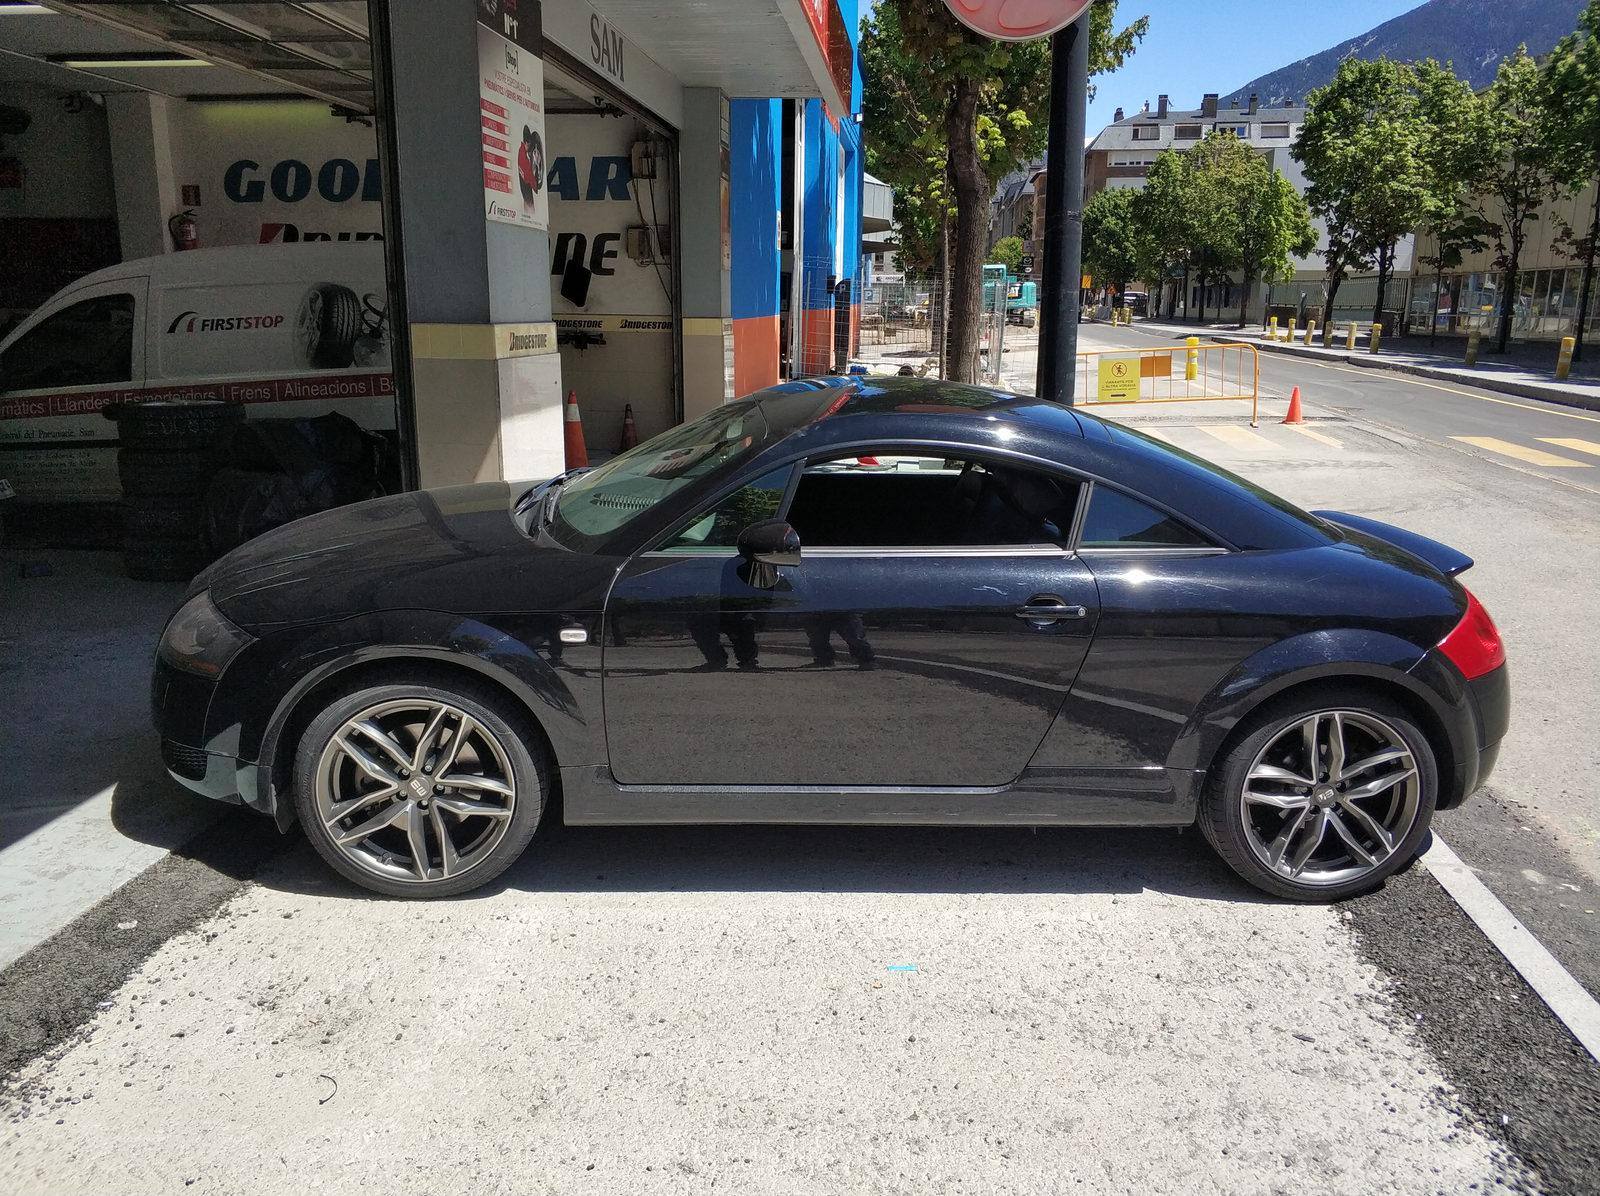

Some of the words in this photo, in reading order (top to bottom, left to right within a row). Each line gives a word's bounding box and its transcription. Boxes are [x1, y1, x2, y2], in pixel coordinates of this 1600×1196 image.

[590, 13, 624, 82] SAM
[497, 207, 516, 219] FIRSTSTOP
[865, 291, 872, 301] P
[201, 315, 285, 332] FIRSTSTOP
[509, 332, 547, 351] BRIDGESTONE
[56, 396, 111, 412] Llandes
[231, 386, 271, 400] Frens
[284, 380, 366, 398] Alineacions
